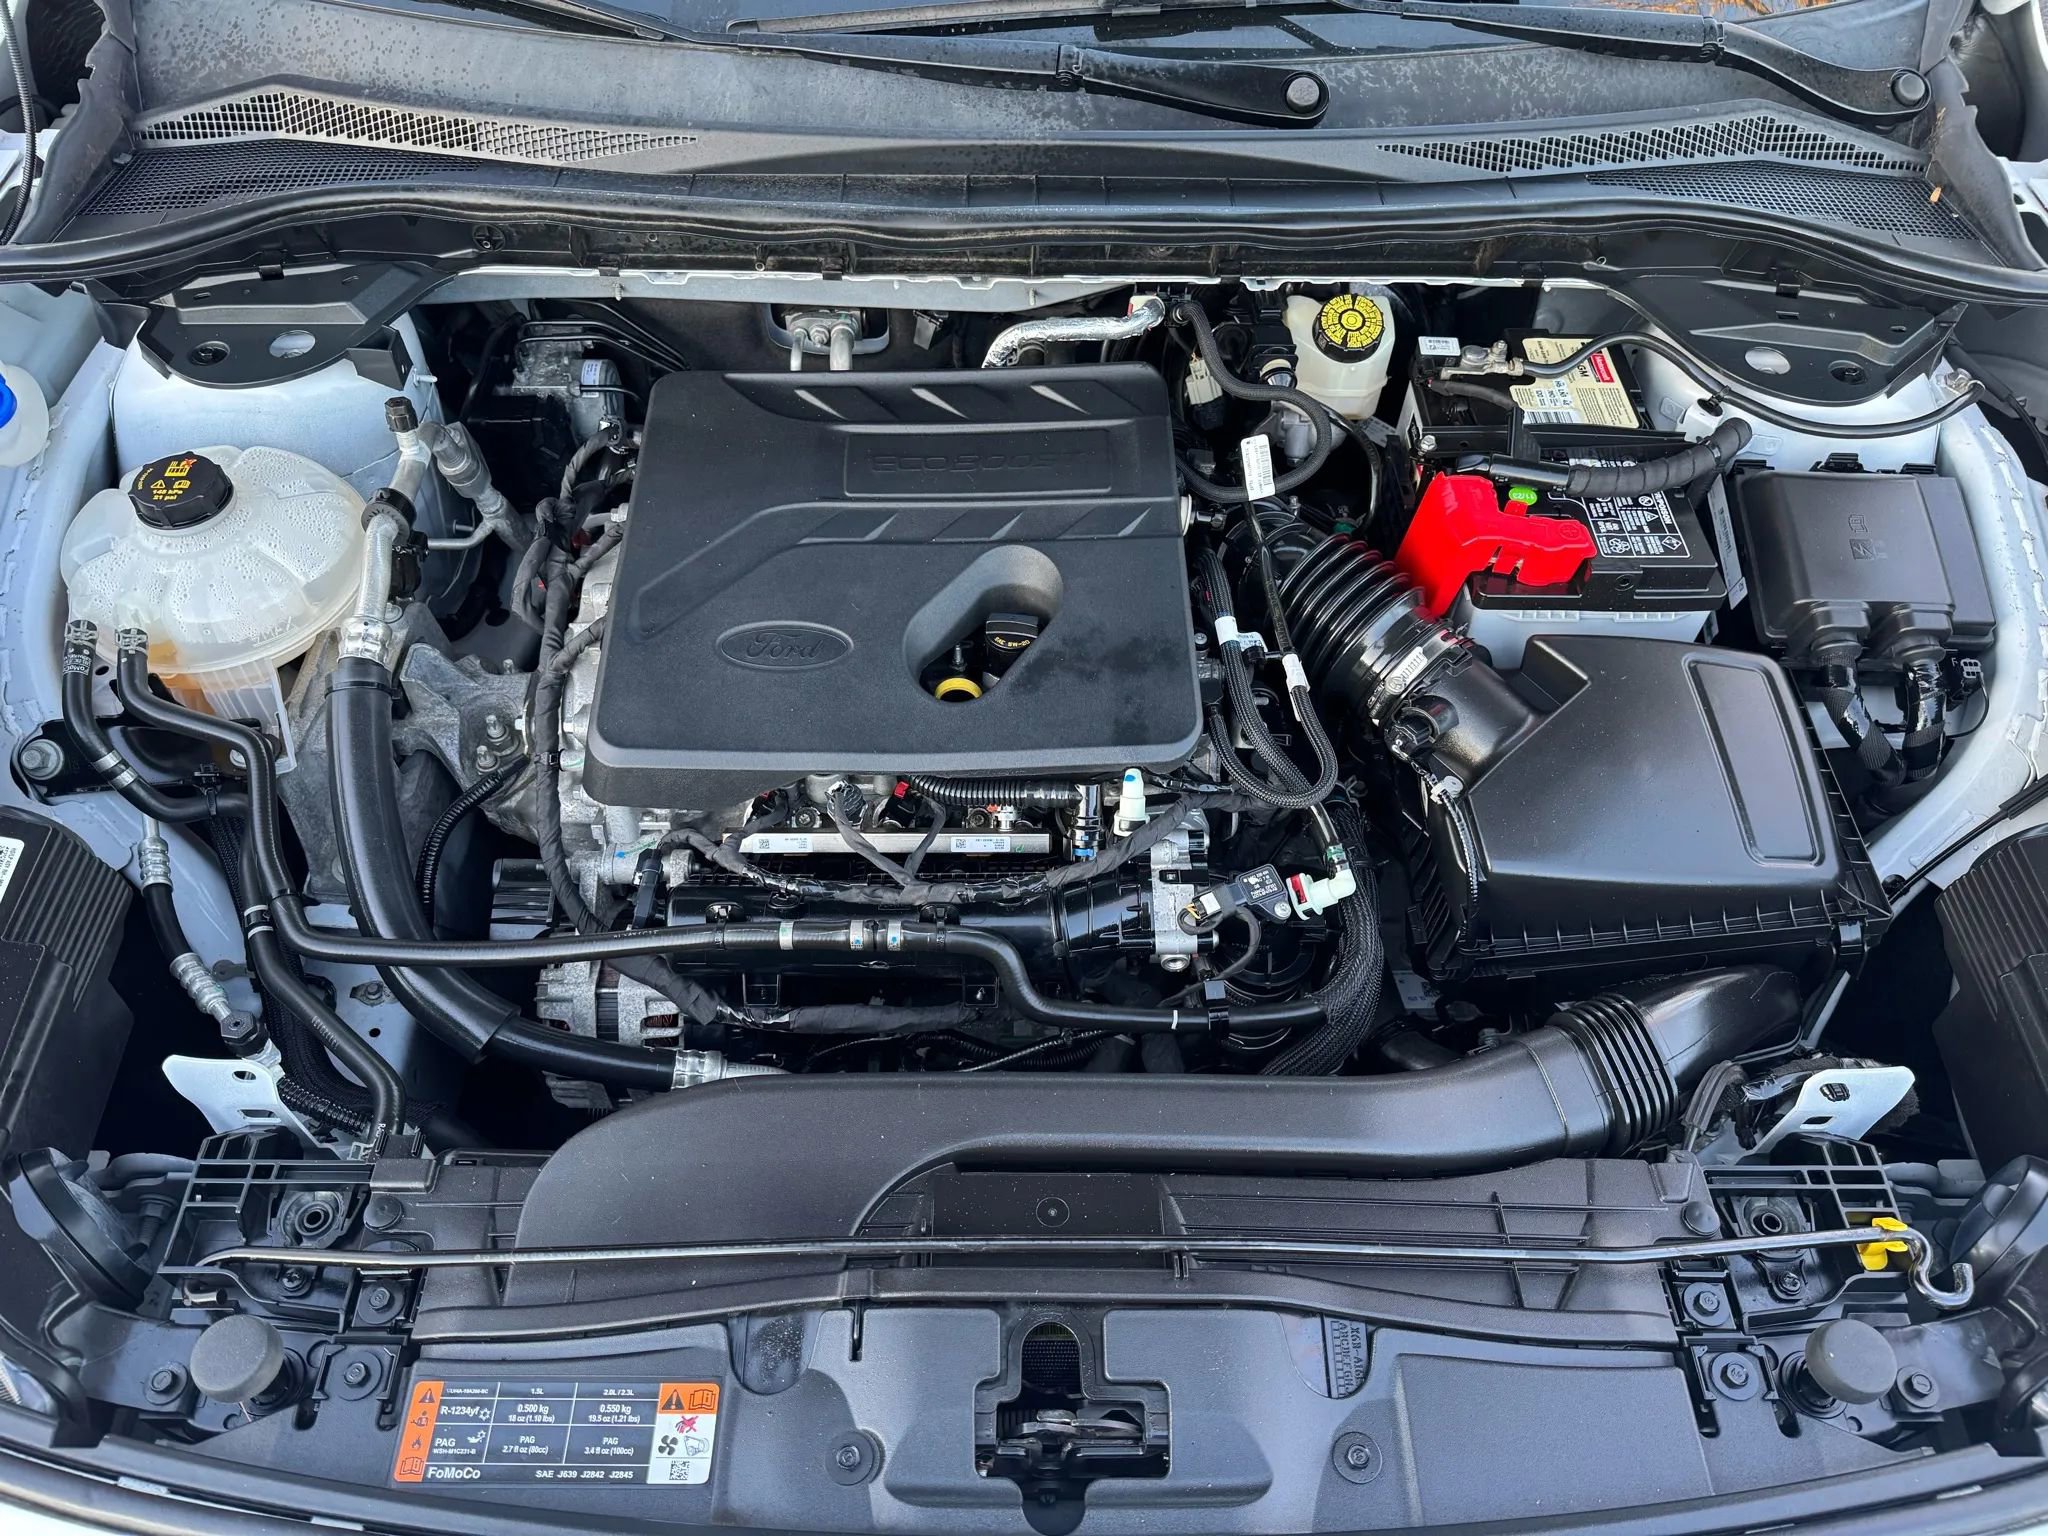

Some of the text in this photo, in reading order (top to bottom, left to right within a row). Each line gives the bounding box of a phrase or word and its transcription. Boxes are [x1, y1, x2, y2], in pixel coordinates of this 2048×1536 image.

[746, 632, 824, 660] Ford
[440, 1406, 480, 1417] R-1234yf
[517, 1403, 549, 1415] 0.500 kg
[599, 1403, 632, 1415] 0.550 kg
[508, 1414, 517, 1422] 18
[542, 1414, 556, 1424] lbs)
[588, 1414, 602, 1422] 19.5
[611, 1415, 627, 1424] (1.21
[627, 1414, 641, 1424] lbs)
[434, 1437, 456, 1447] PAG
[519, 1435, 536, 1444] PAG
[602, 1436, 619, 1445] PAG
[502, 1445, 513, 1453] 2.7
[427, 1466, 481, 1479] FoMoCo
[535, 1470, 634, 1479] SAE J639 J2842 J2845
